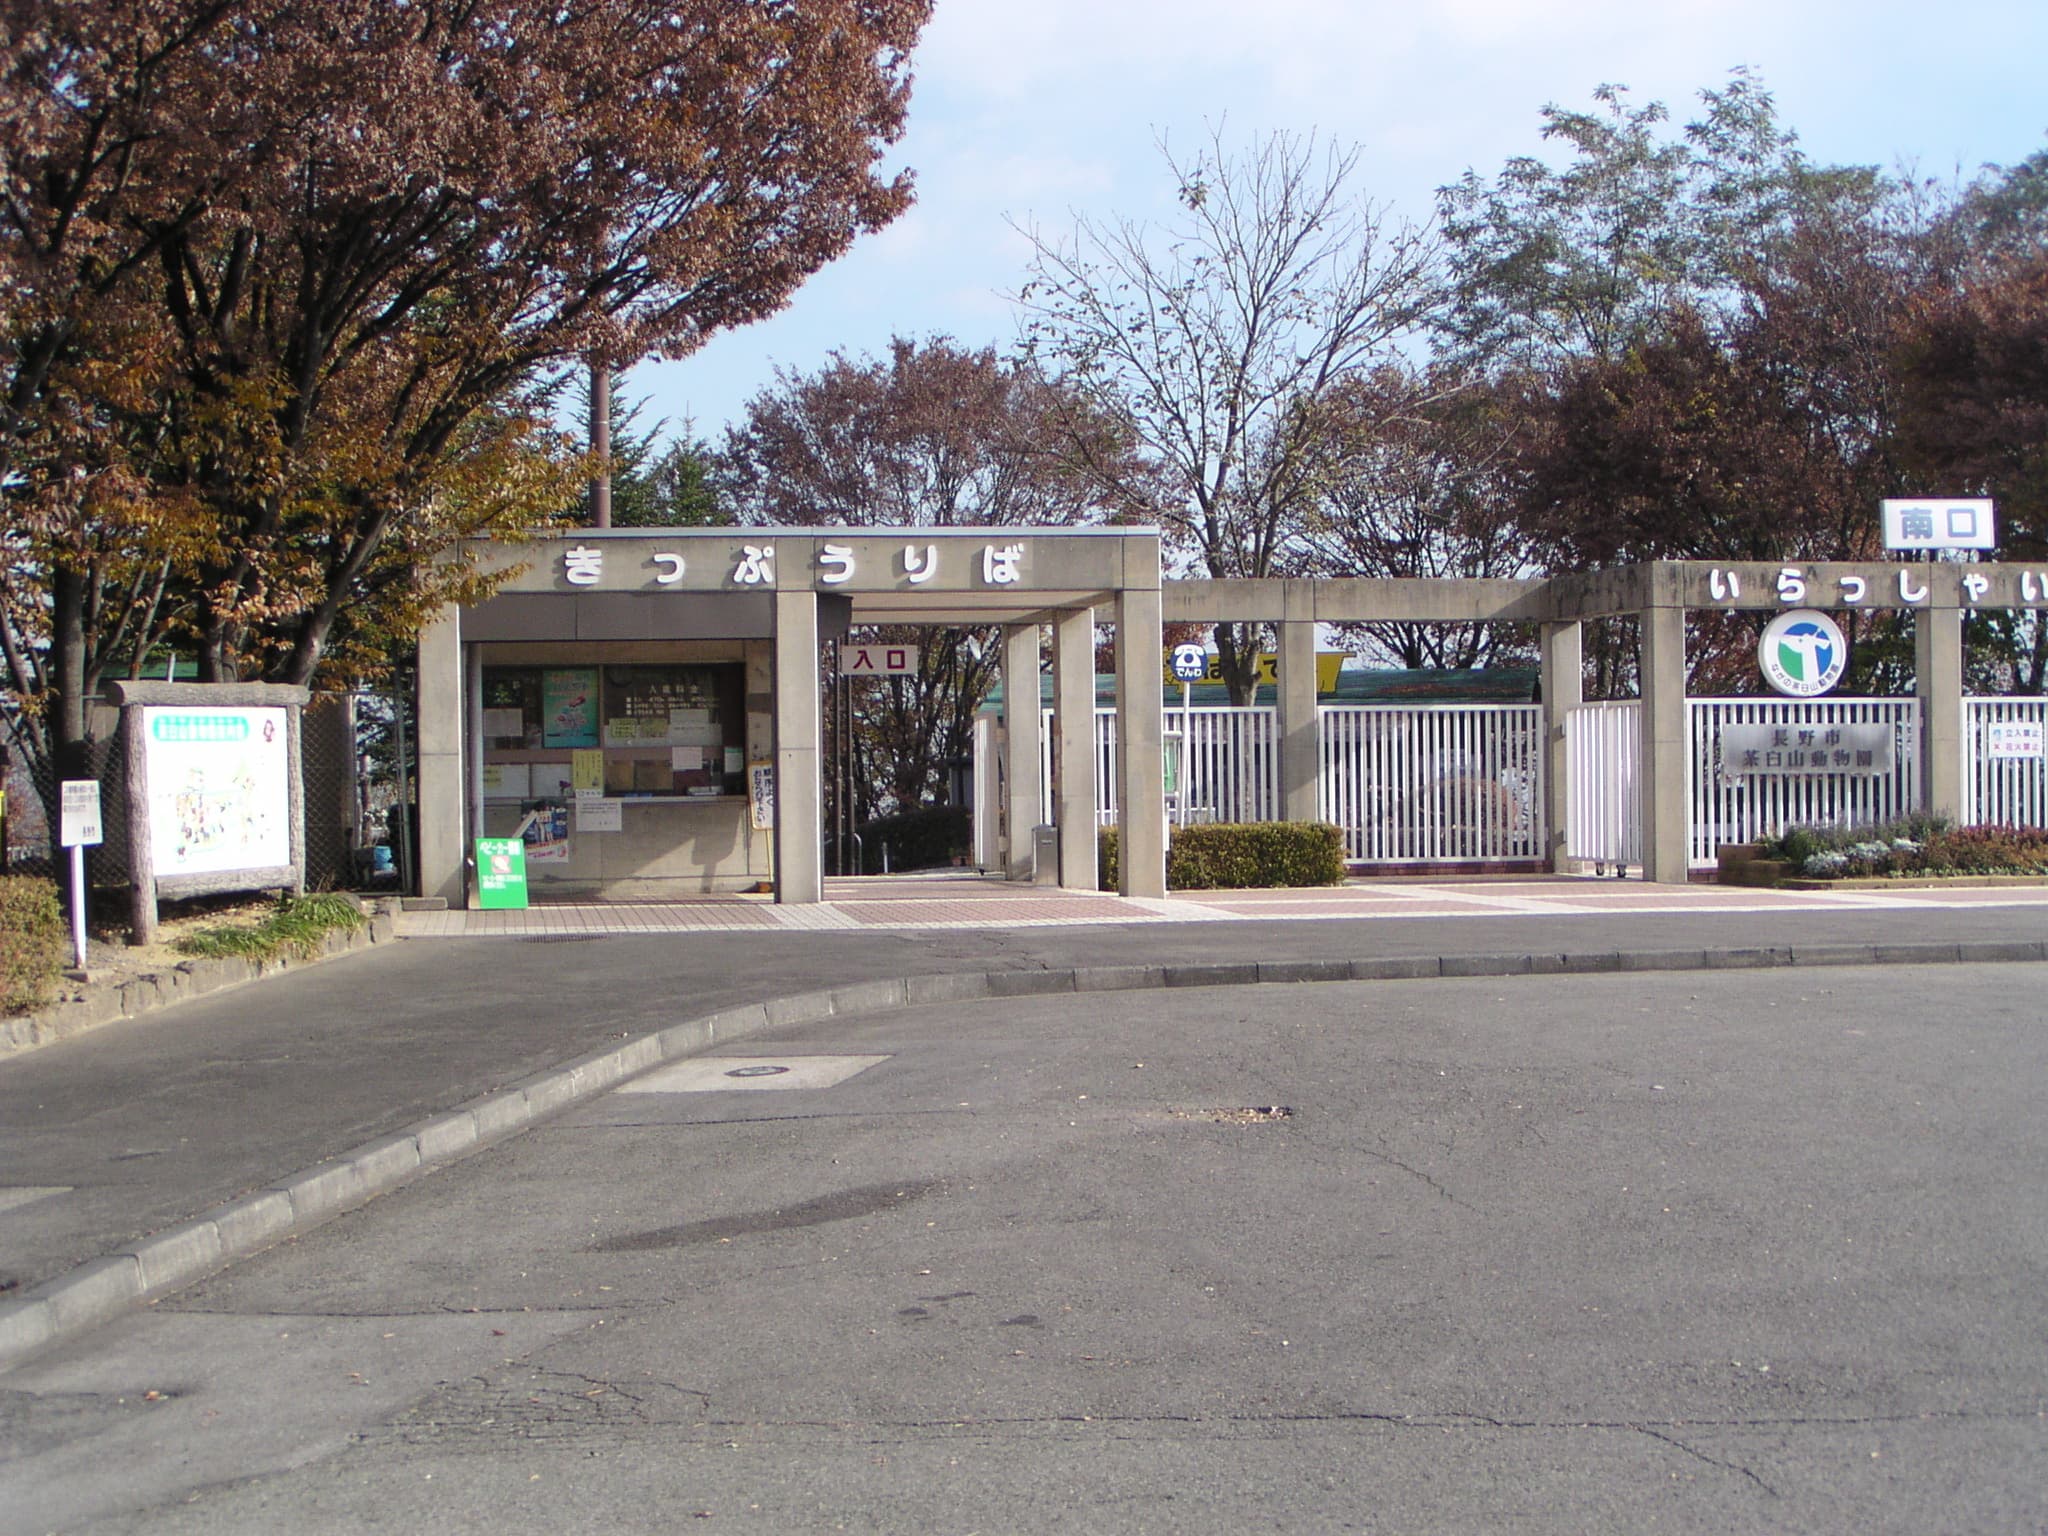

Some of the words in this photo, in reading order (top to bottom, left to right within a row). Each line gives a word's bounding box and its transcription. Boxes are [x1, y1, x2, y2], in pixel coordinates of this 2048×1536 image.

[1901, 508, 1977, 539] 南口
[564, 543, 1025, 584] きっぷうりば
[1710, 569, 2048, 602] いらっしゃい
[852, 648, 906, 671] 入口
[1772, 729, 1841, 747] 長野市
